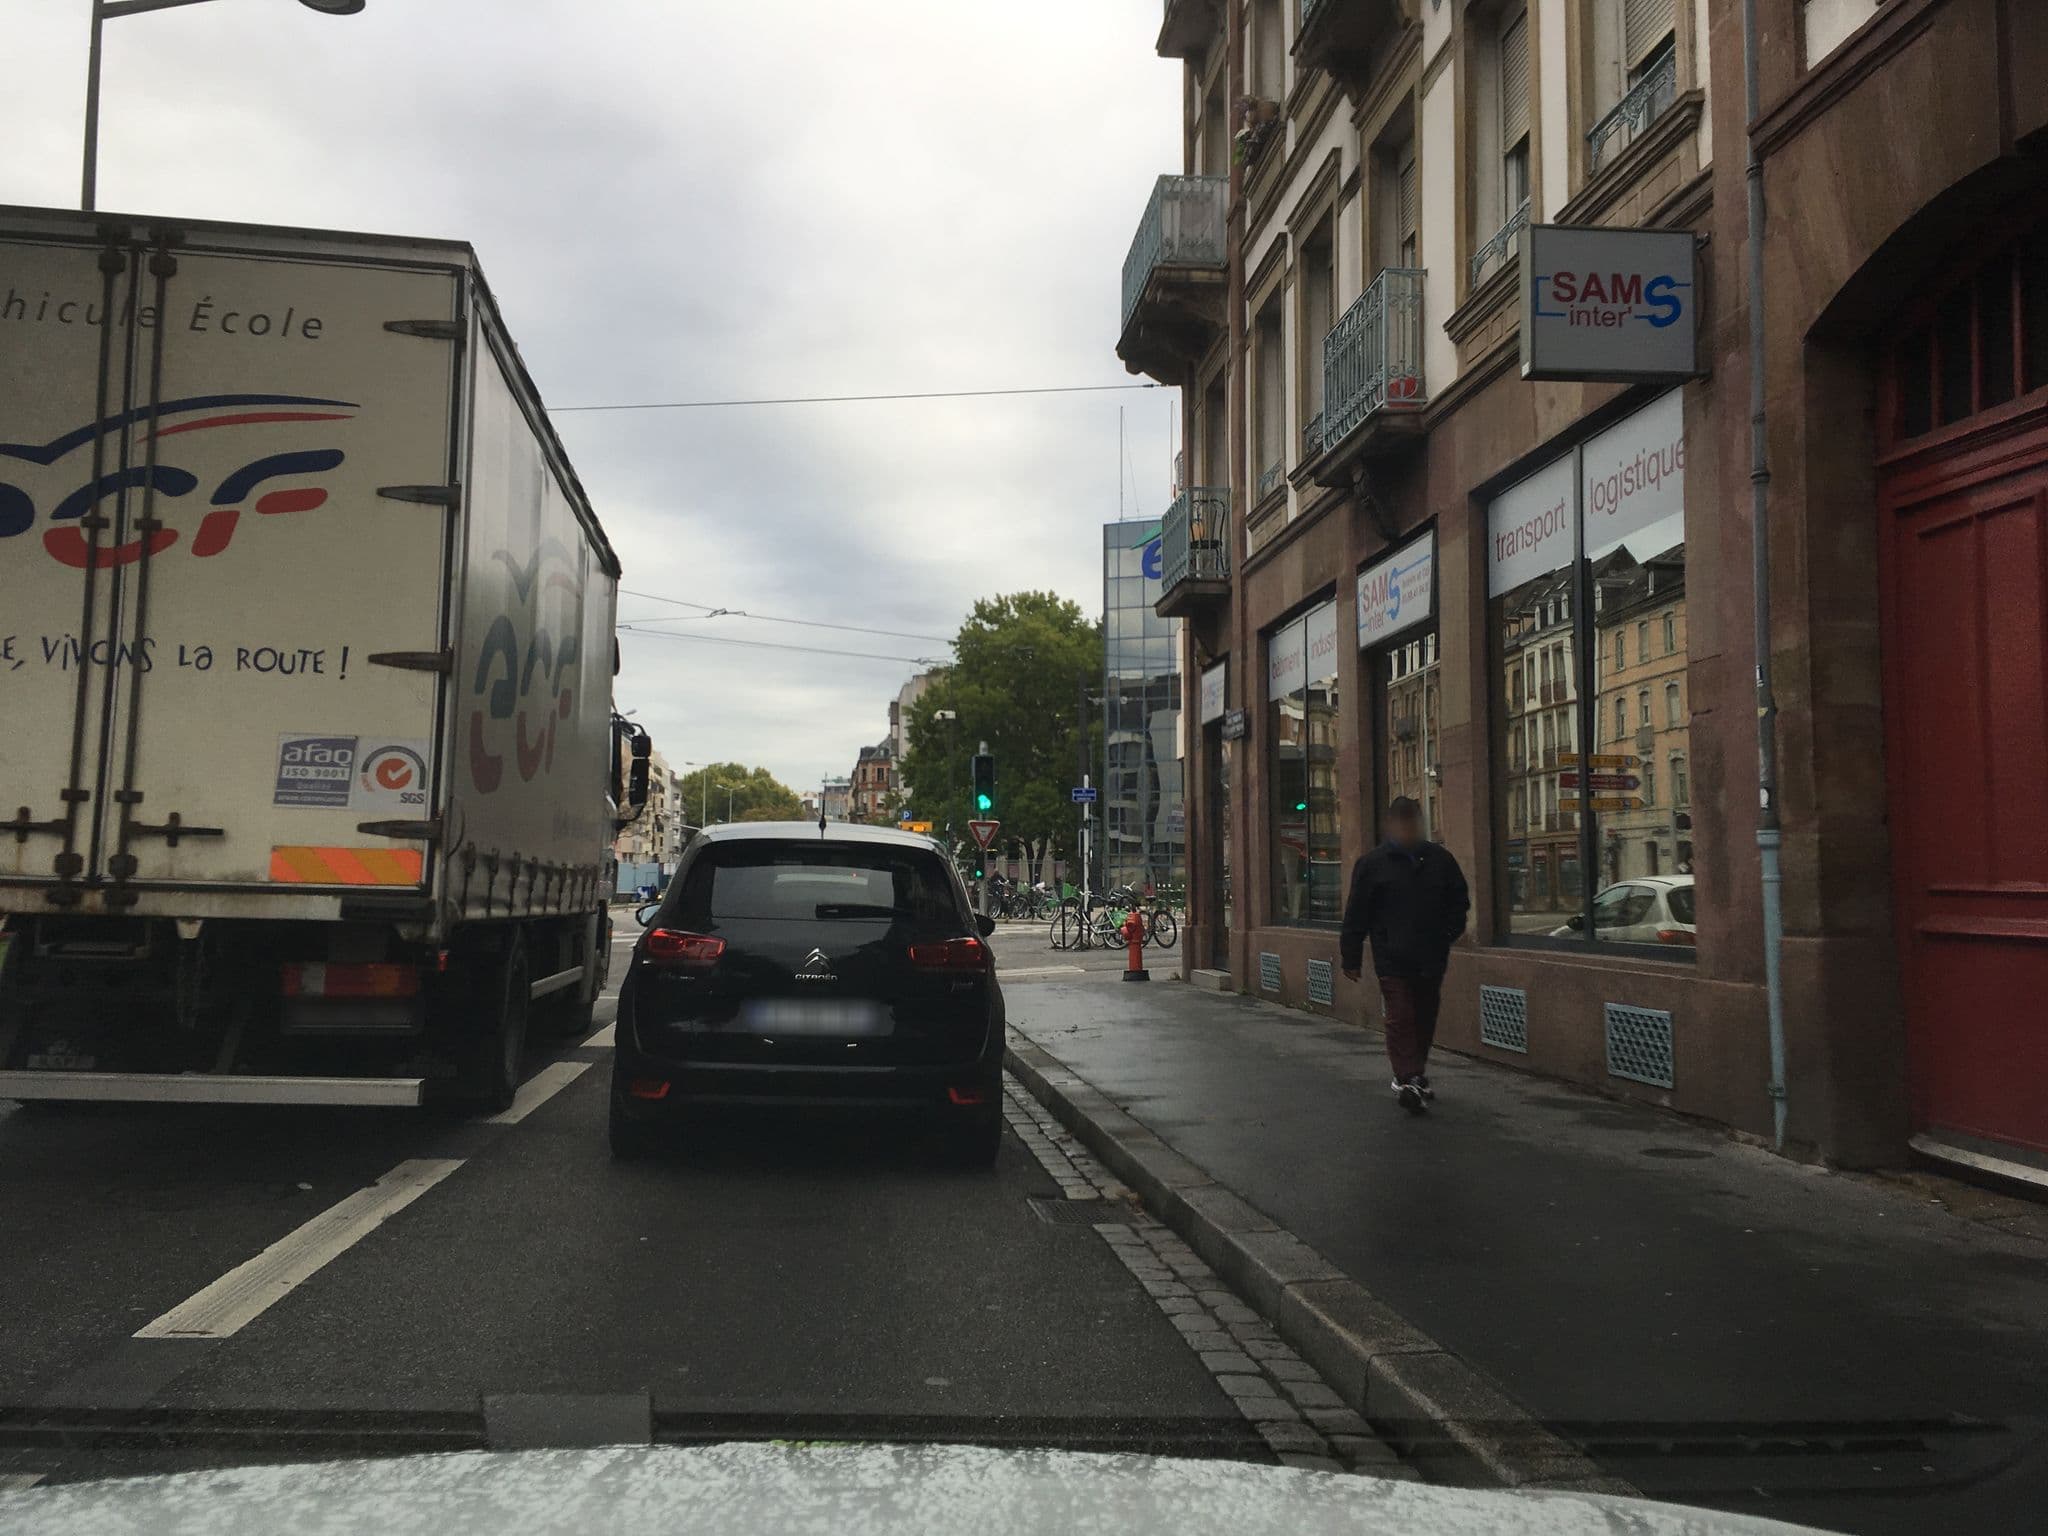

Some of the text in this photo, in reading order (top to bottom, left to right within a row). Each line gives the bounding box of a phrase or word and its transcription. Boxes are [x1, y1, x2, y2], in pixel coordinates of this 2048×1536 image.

[1, 289, 323, 340] hicule École
[1590, 437, 1685, 515] logistique
[1495, 497, 1567, 562] transport
[237, 647, 325, 674] ROUTE
[284, 743, 352, 767] afaq
[285, 766, 346, 779] ISO 9001
[400, 792, 424, 804] SGS
[903, 810, 910, 820] P
